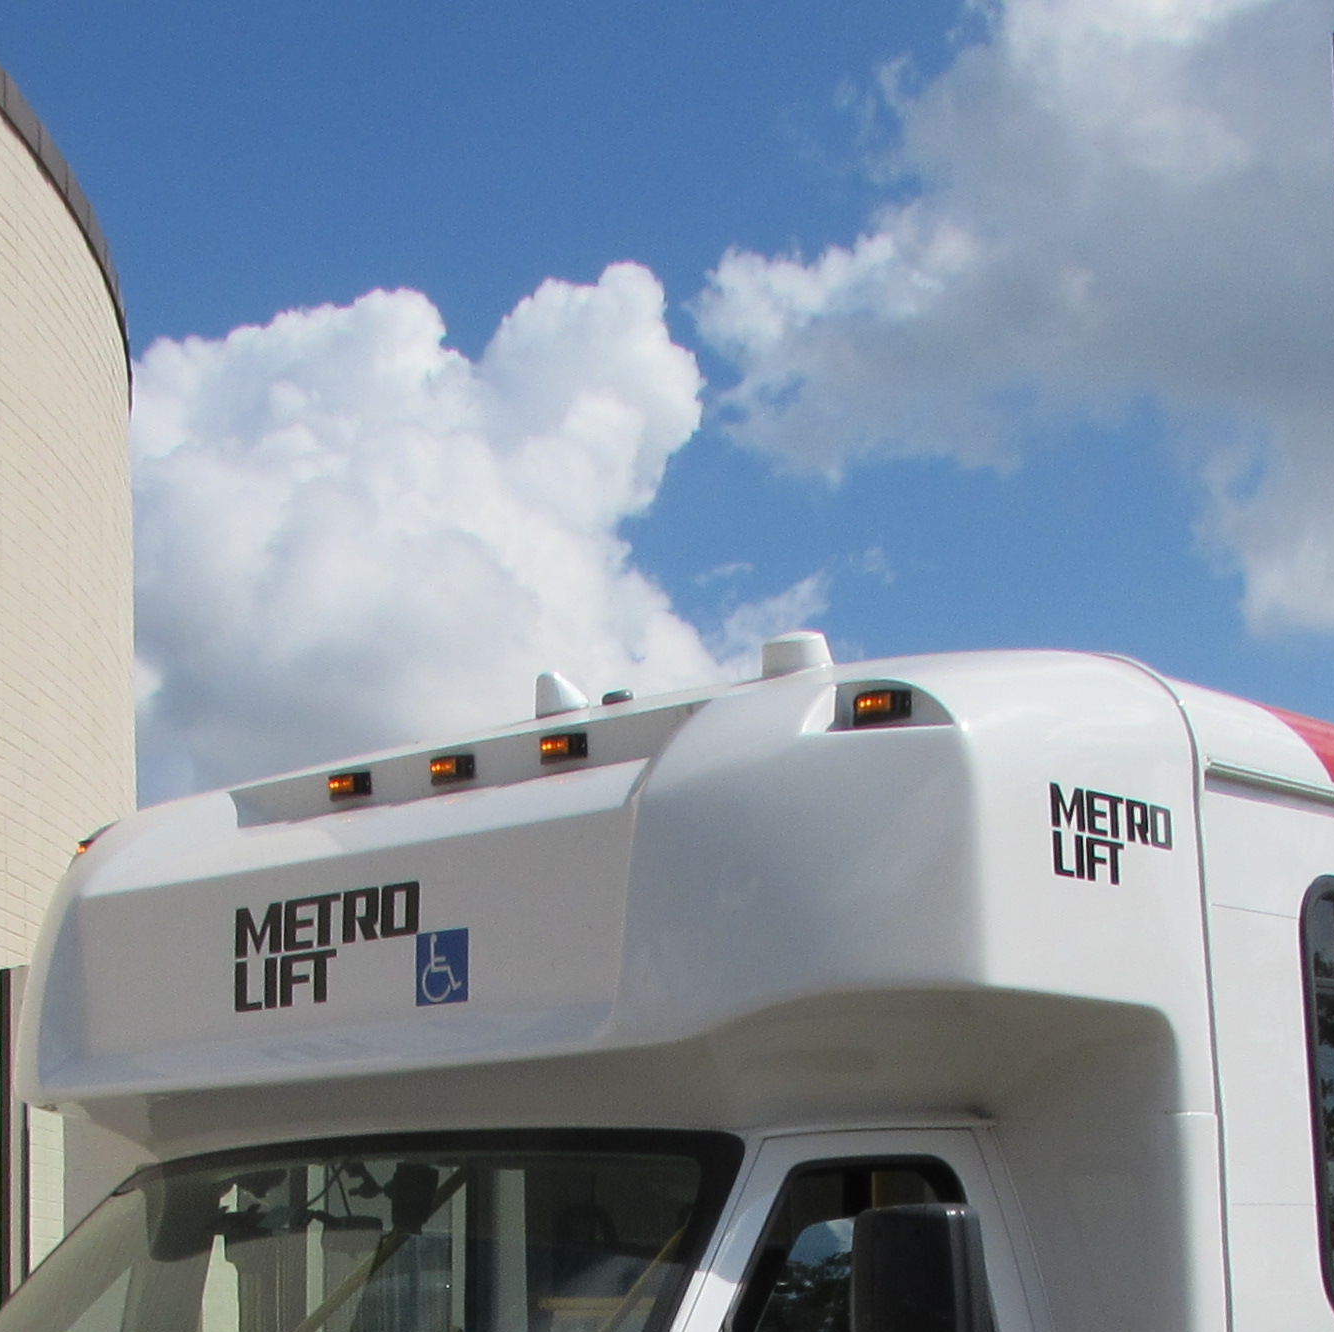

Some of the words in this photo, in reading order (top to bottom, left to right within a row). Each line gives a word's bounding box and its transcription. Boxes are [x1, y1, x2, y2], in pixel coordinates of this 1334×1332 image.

[1049, 781, 1173, 851] METRO
[1051, 829, 1125, 886] LIFT
[235, 880, 420, 959] METRO
[235, 948, 338, 1013] LIFT
